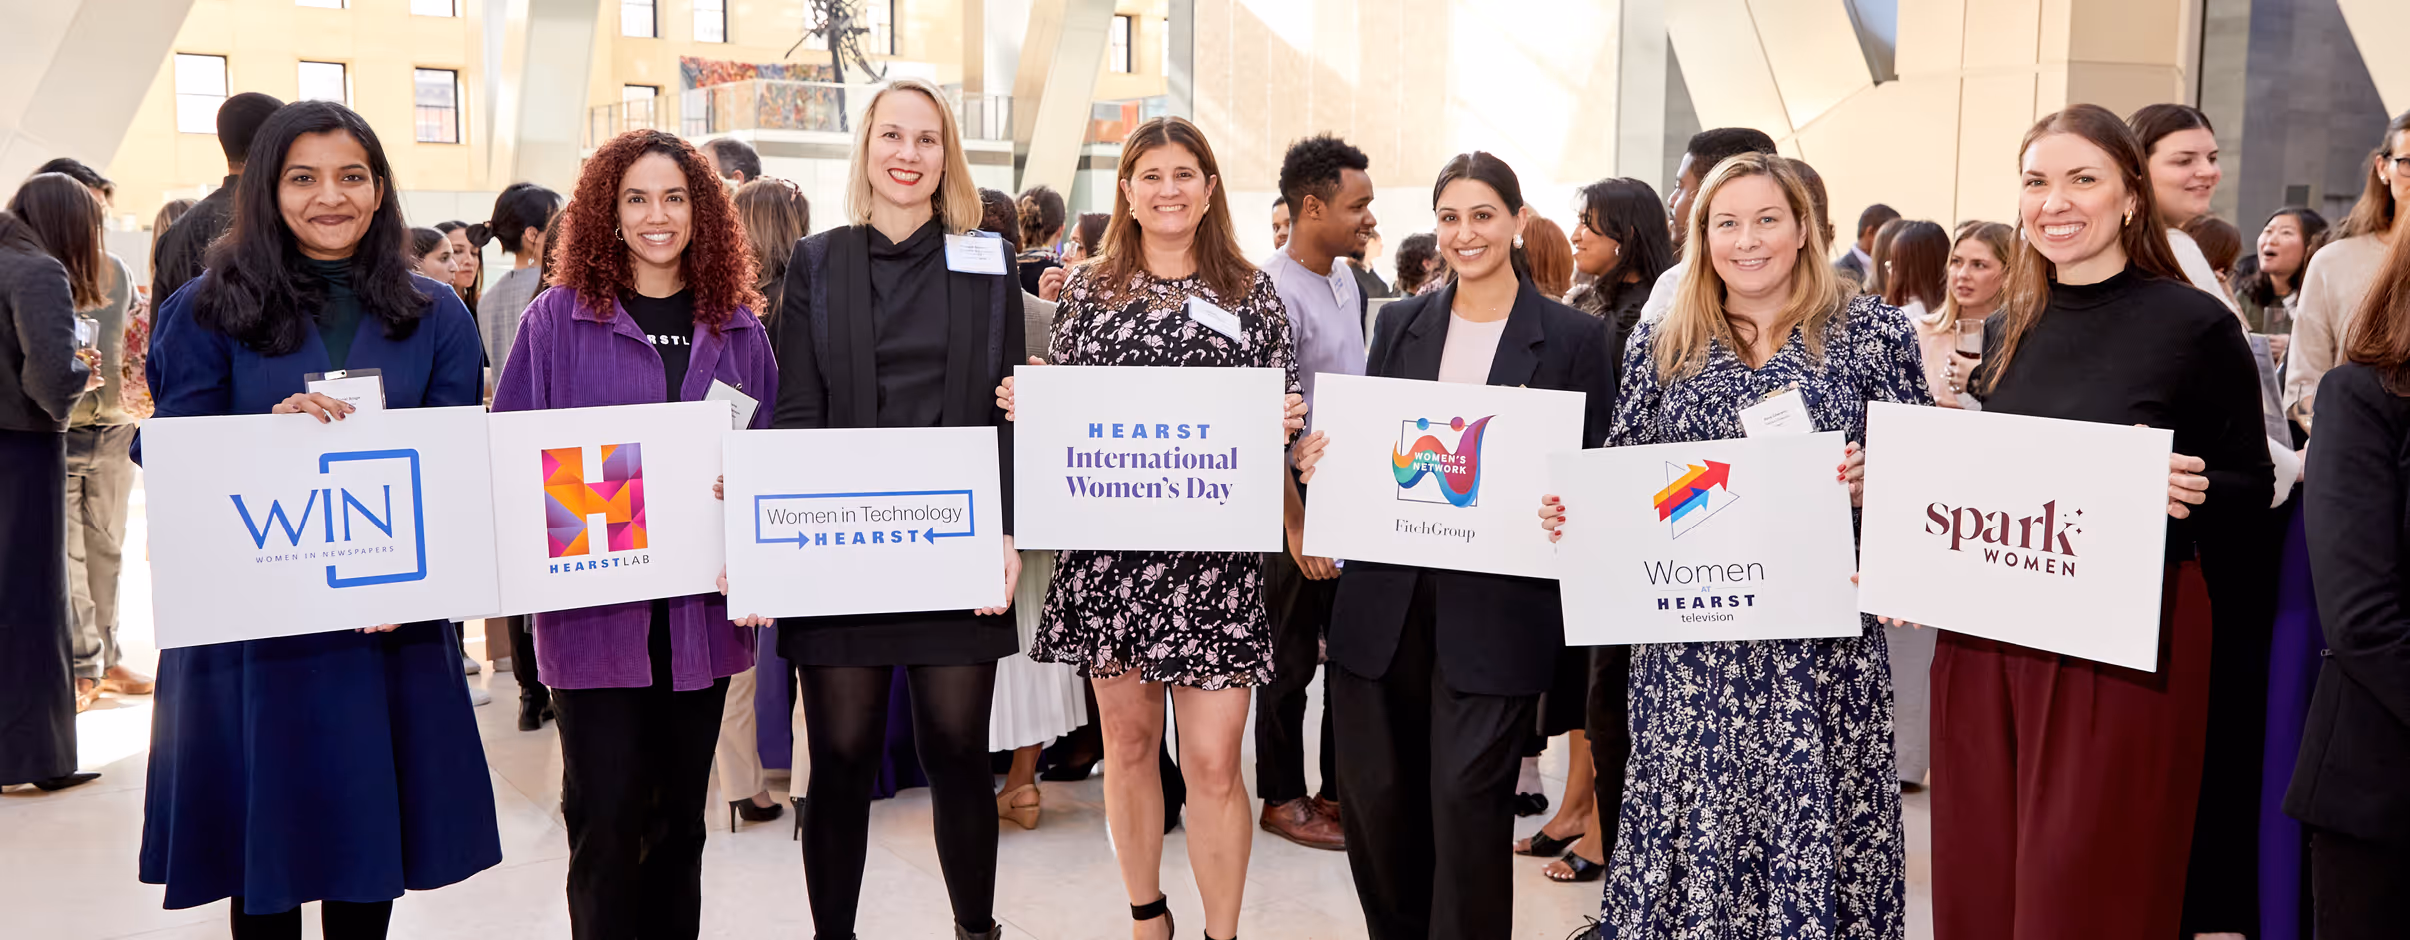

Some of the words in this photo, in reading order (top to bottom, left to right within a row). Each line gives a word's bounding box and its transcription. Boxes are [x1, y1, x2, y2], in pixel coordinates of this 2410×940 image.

[1088, 423, 1210, 439] HEARST
[1066, 446, 1238, 469] International
[1412, 461, 1467, 475] NETWORK
[1414, 452, 1467, 464] WOMEN'S
[541, 442, 648, 558] H
[1065, 476, 1180, 499] Women's
[1186, 477, 1233, 505] Day
[229, 484, 393, 550] WIN
[767, 508, 837, 525] Women
[841, 507, 856, 523] in
[860, 504, 963, 524] Technology
[814, 530, 919, 546] HEARST
[1395, 518, 1476, 543] FitchGroup
[1925, 499, 2080, 557] spark
[256, 554, 298, 564] WOMEN
[322, 545, 394, 558] NEWSPAPERS
[549, 554, 651, 574] HEARSTLAB
[1984, 548, 2076, 577] WOMEN
[1643, 559, 1764, 585] Women
[1657, 594, 1755, 610] HEARST
[1681, 612, 1734, 622] television
